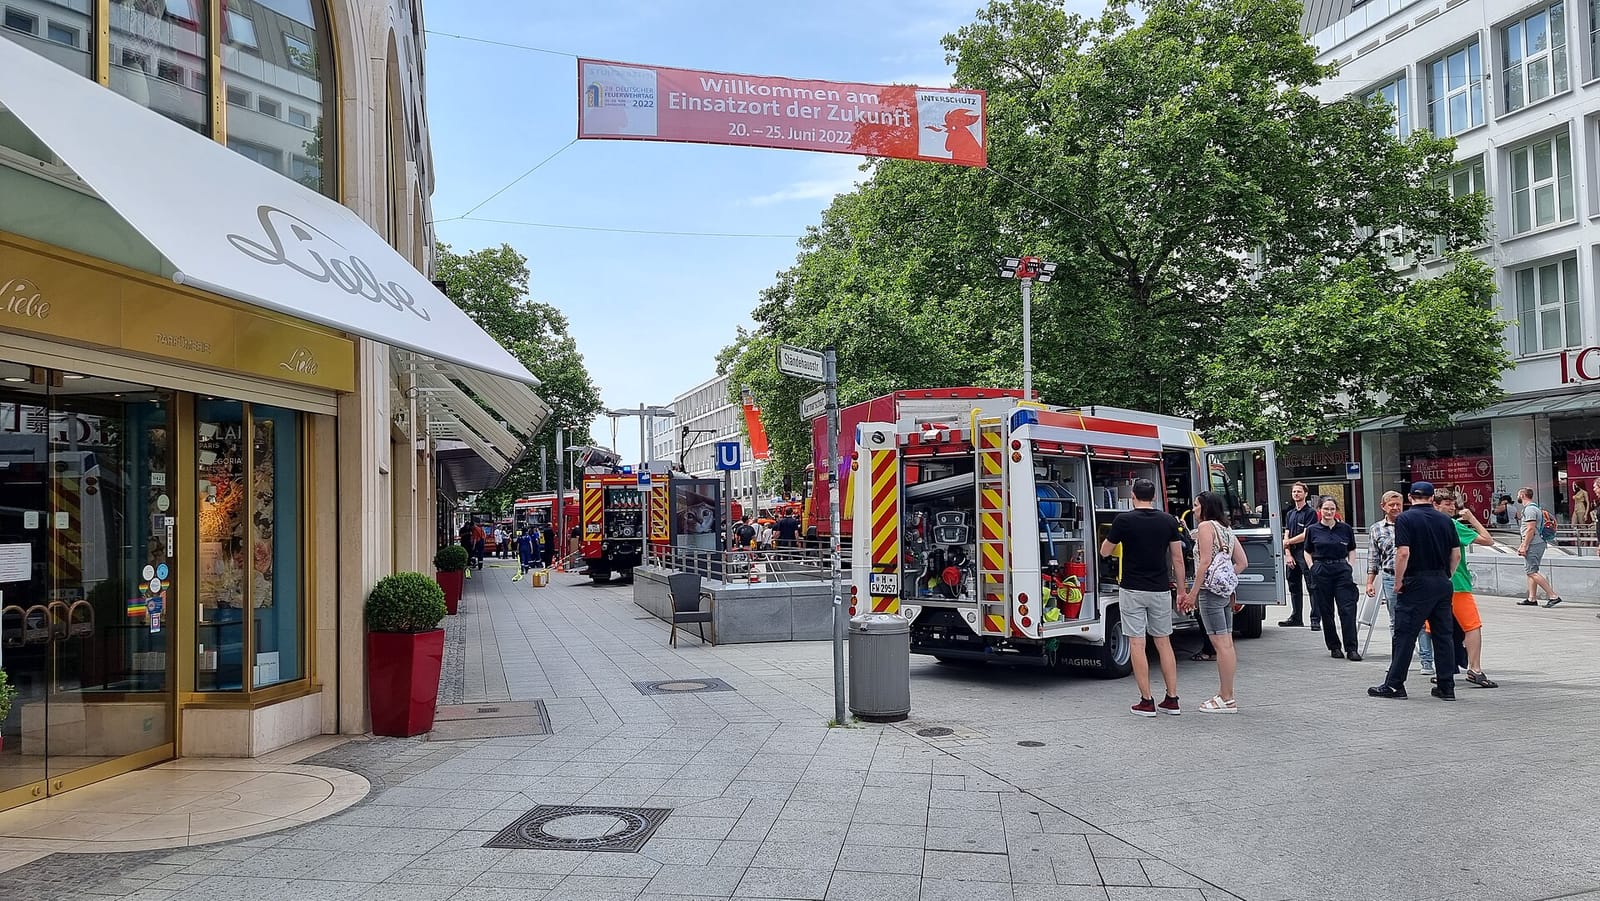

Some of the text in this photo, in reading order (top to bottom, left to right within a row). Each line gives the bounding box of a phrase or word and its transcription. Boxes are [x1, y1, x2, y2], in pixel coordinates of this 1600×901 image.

[700, 77, 880, 104] Willkommen am
[632, 100, 654, 108] 2022
[921, 95, 977, 106] INTERSCHUTZ
[669, 92, 912, 128] Einsatzort der Zukunft
[728, 123, 750, 137] 20.
[765, 125, 785, 140] 25.
[788, 127, 816, 142] Juni
[819, 129, 851, 144] 2022
[227, 205, 431, 321] Liebe
[280, 346, 319, 376] Liebe
[721, 446, 738, 466] U
[1421, 469, 1445, 480] WELLE
[881, 575, 887, 584] H
[872, 584, 896, 593] FW 2957
[1061, 658, 1102, 667] MAGIRUS
